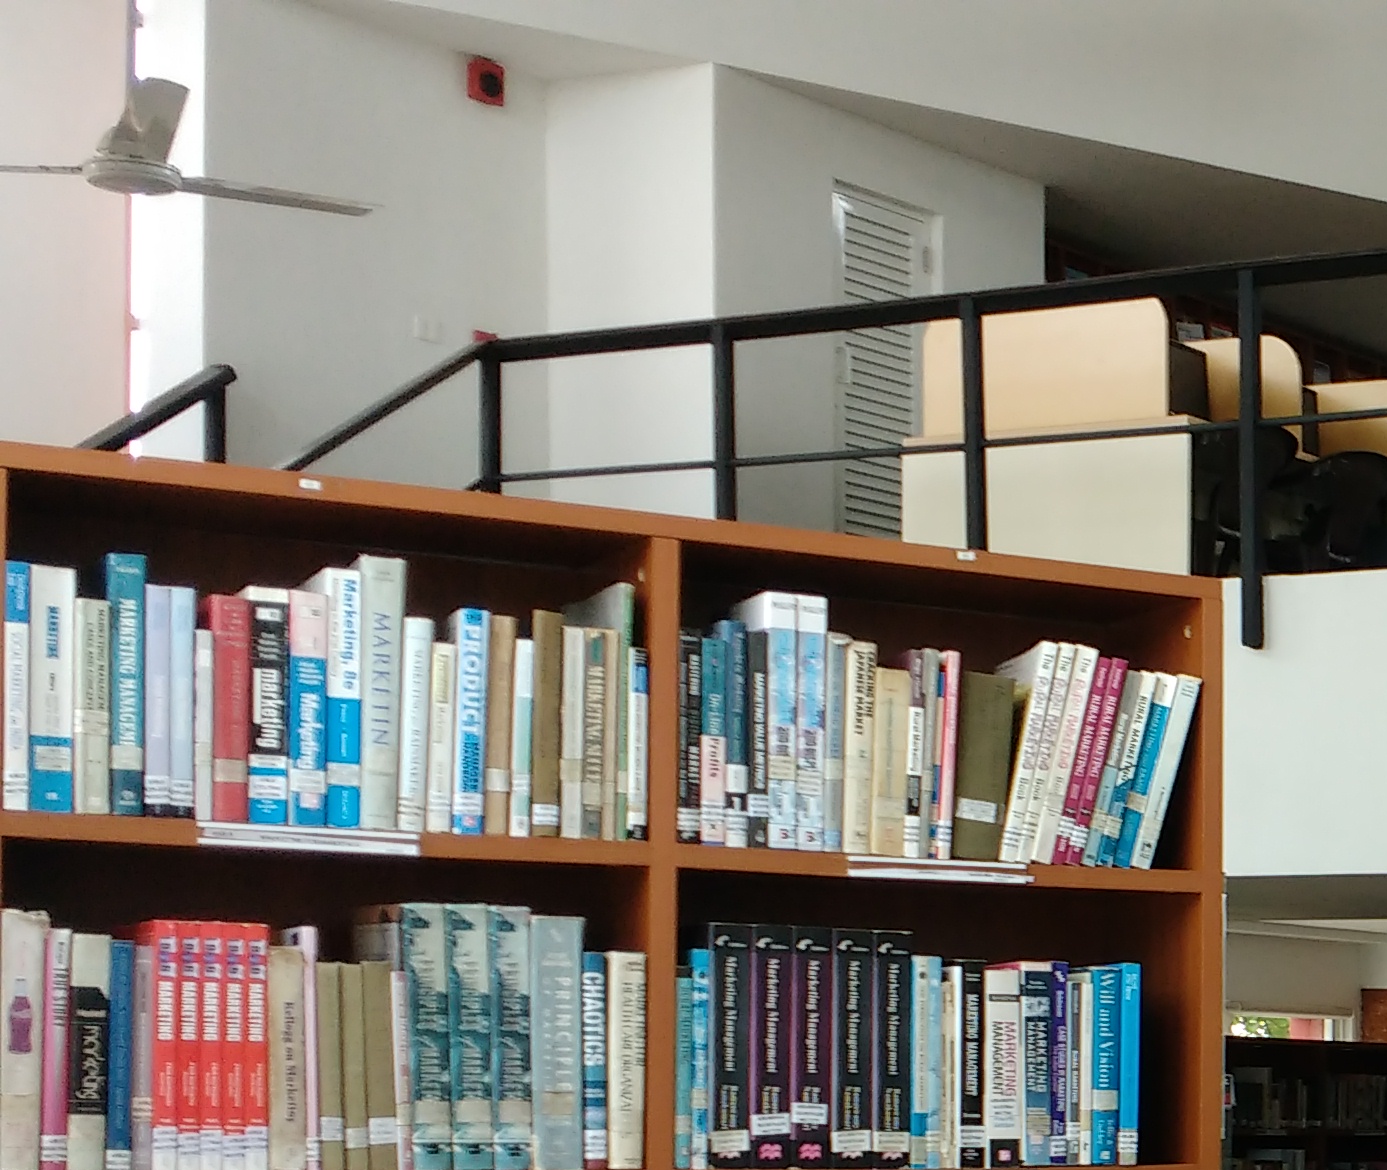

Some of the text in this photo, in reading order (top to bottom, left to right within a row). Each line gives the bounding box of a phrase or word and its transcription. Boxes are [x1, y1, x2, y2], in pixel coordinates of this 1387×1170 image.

[119, 598, 138, 675] MARKETING
[341, 578, 358, 690] Marketing, 8e
[1041, 653, 1054, 671] The
[1059, 655, 1072, 672] The
[1079, 657, 1092, 674] The
[256, 668, 286, 749] marketing
[461, 624, 482, 735] PRODUCT
[855, 650, 865, 736] JAPANESE MARKET
[1133, 696, 1148, 726] RURAL
[296, 693, 325, 769] Marketing
[1075, 694, 1101, 777] RURAL MARKETING
[1090, 695, 1117, 778] RURAL MARKETING
[157, 981, 172, 1040] MARKETING
[180, 981, 196, 1040] MARKETING
[203, 981, 218, 1041] MARKETING
[226, 983, 241, 1041] MARKETING
[248, 983, 263, 1041] MARKETING
[583, 972, 603, 1067] CHAOTICS
[723, 956, 738, 1072] Marketing Management
[765, 958, 780, 1073] Marketing Management
[805, 959, 820, 1074] Marketing Management
[845, 960, 860, 1074] Marketing Management
[886, 963, 900, 1076] Marketing Management
[965, 994, 979, 1096] MARKETING MANAGEMENT
[1098, 972, 1115, 1088] Will and Vision
[282, 1001, 297, 1122] Kellogg Marketing
[991, 1020, 1004, 1096] MANAGEMENT
[1004, 1020, 1017, 1096] MARKETING
[1026, 1021, 1036, 1093] MANAGEMENT
[1036, 1021, 1048, 1093] MARKETING
